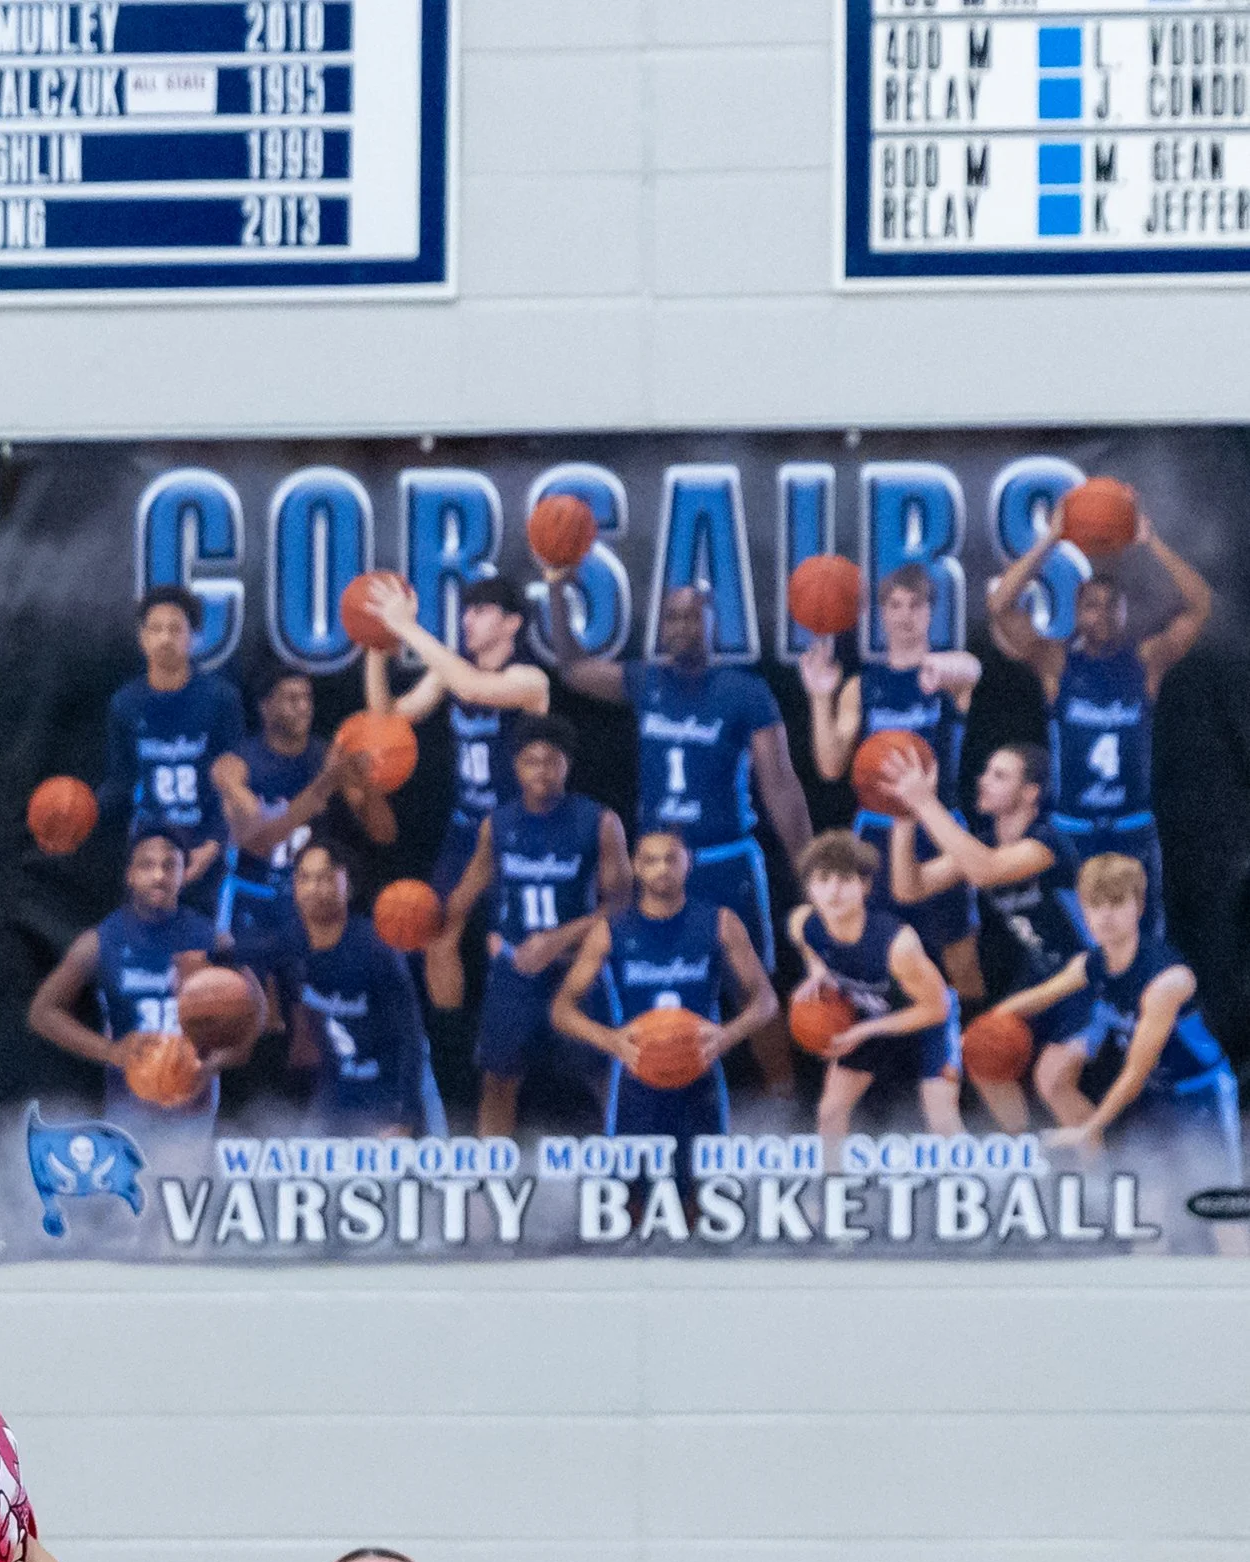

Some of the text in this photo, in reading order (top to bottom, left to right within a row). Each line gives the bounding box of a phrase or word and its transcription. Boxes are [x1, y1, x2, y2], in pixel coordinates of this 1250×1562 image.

[244, 1, 325, 52] 2010
[885, 23, 941, 69] 400
[247, 63, 325, 115] 1995
[884, 73, 981, 121] RELAY
[247, 127, 324, 181] 1999
[883, 142, 940, 188] 800
[241, 193, 321, 246] 2013
[881, 193, 979, 240] RELAY
[218, 1133, 1050, 1179] WATERFORD MOTT HIGH SCHOOL
[160, 1174, 1160, 1243] VARSITY BASKETBALL
